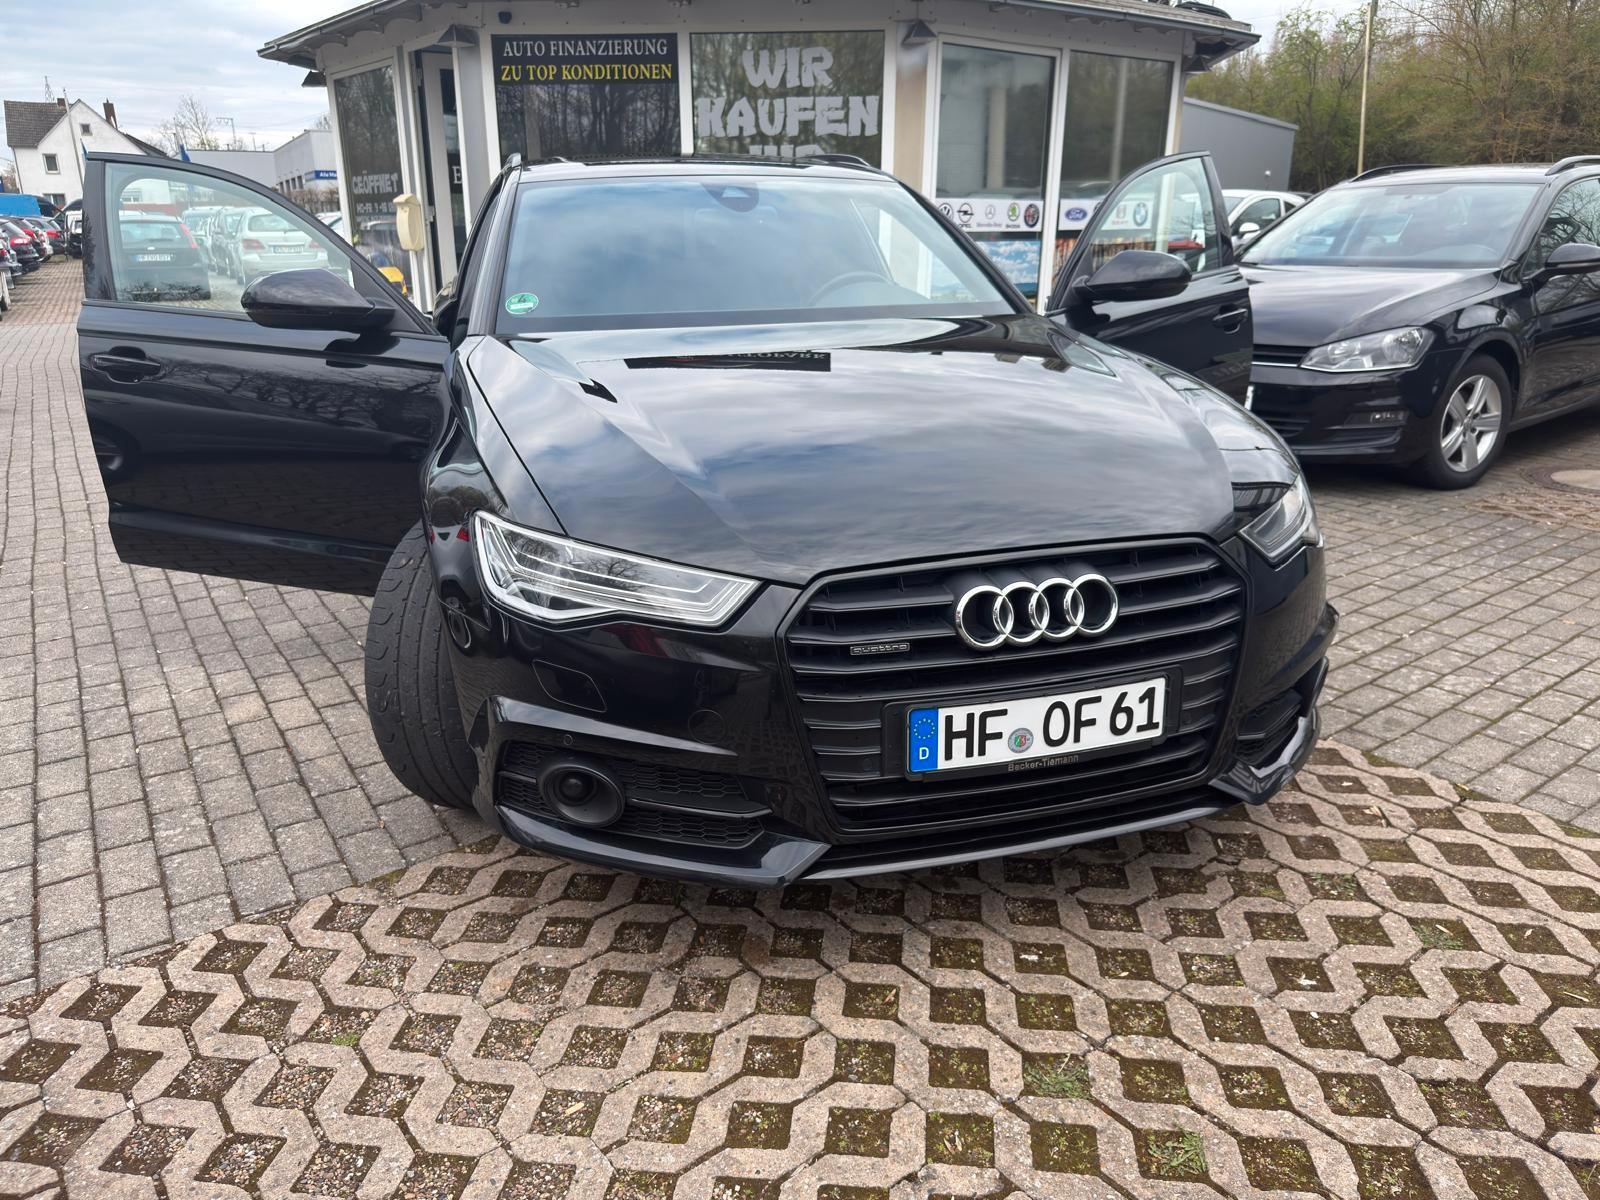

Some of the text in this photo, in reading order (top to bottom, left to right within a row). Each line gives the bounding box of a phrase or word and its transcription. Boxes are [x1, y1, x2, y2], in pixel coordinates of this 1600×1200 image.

[503, 39, 668, 57] AUTO FINANZIERUNG
[501, 64, 672, 81] ZU TOP KONDITIONEN
[742, 46, 834, 89] WIR
[699, 95, 880, 137] KAUFEN
[352, 170, 399, 194] GEÖFFNET
[853, 644, 907, 655] quattro
[944, 708, 1008, 761] HF
[918, 746, 929, 760] D
[1007, 755, 1079, 772] Becker-Tiemann
